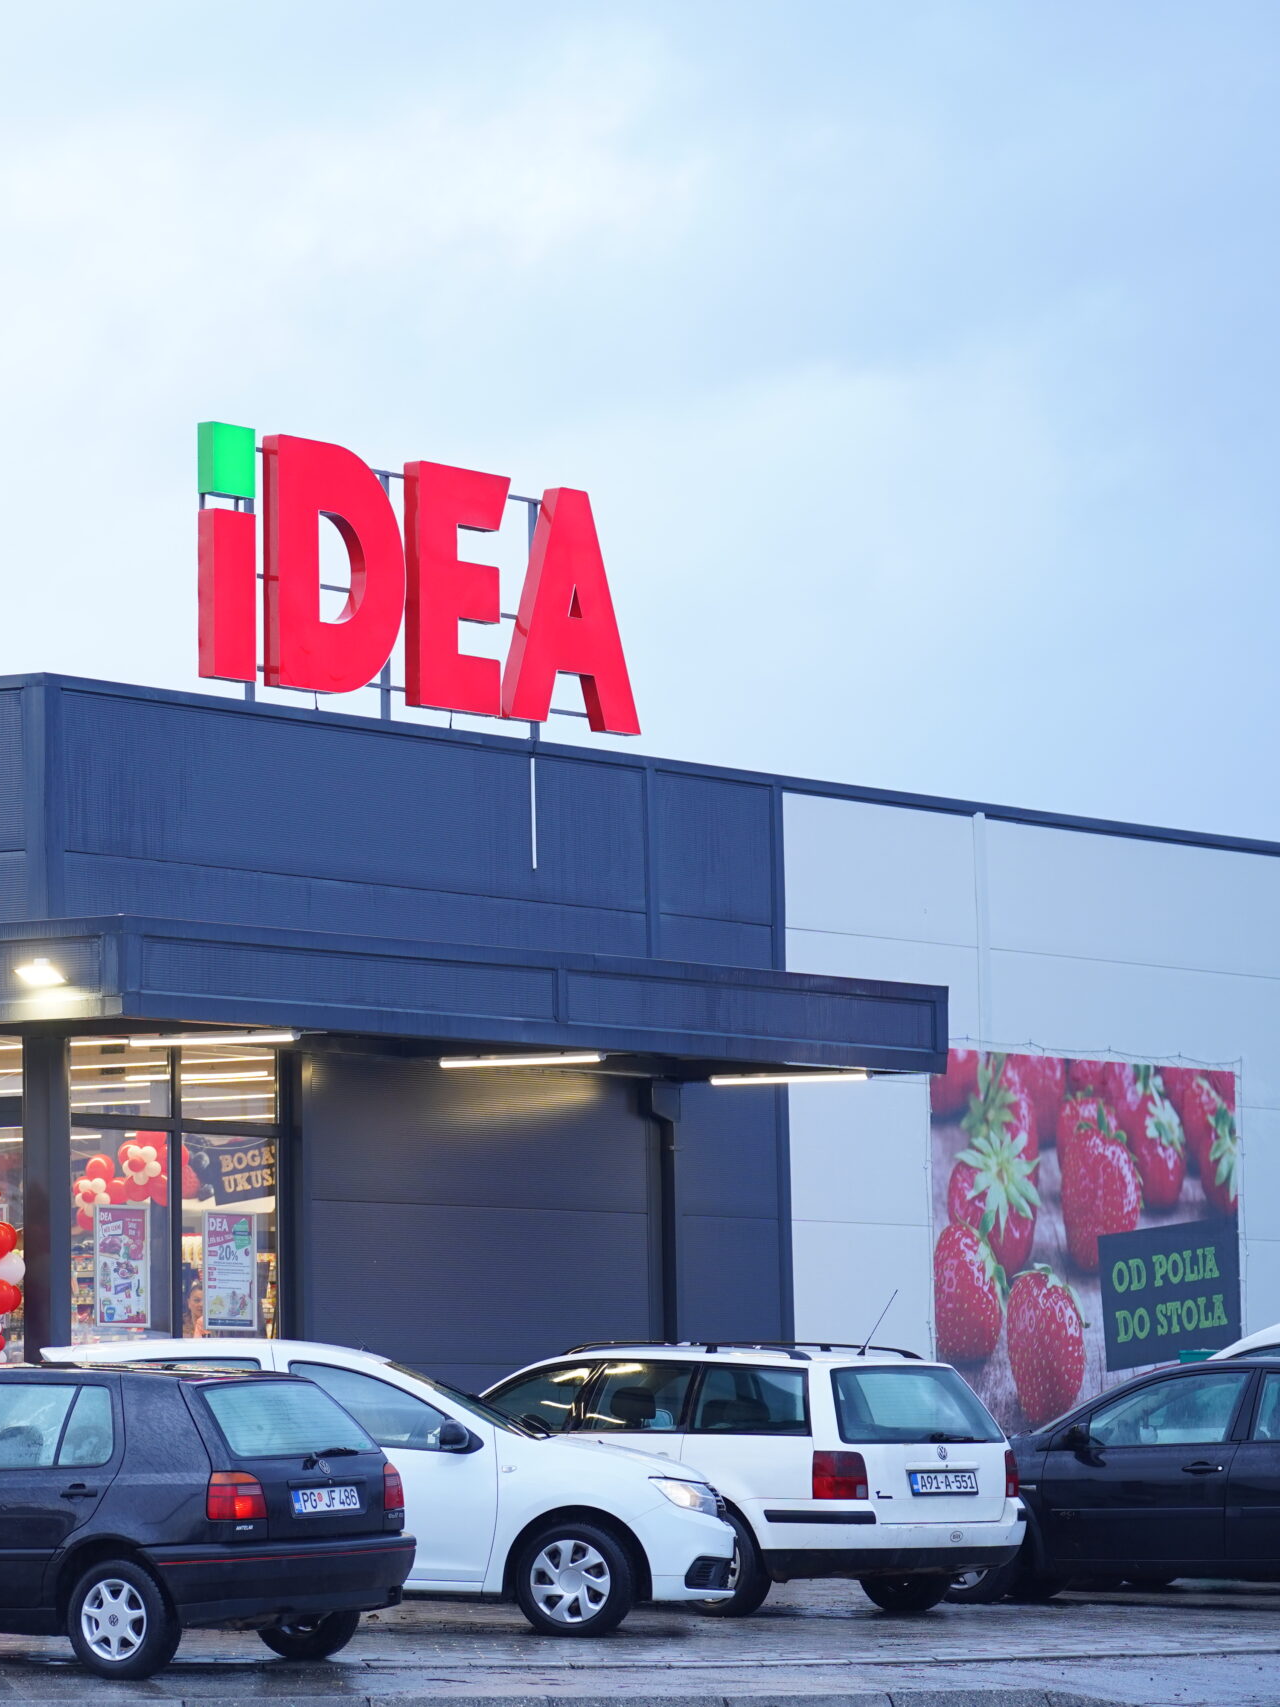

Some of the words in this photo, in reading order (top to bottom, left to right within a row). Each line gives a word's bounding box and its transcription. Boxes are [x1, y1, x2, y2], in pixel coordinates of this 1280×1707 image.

[222, 1168, 275, 1192] UKUS
[208, 1217, 229, 1232] DEA
[1112, 1258, 1146, 1293] OD
[1152, 1246, 1220, 1287] POLJA
[1115, 1307, 1150, 1343] DO
[1156, 1294, 1228, 1336] STOLA
[920, 1475, 975, 1490] A91-A-551
